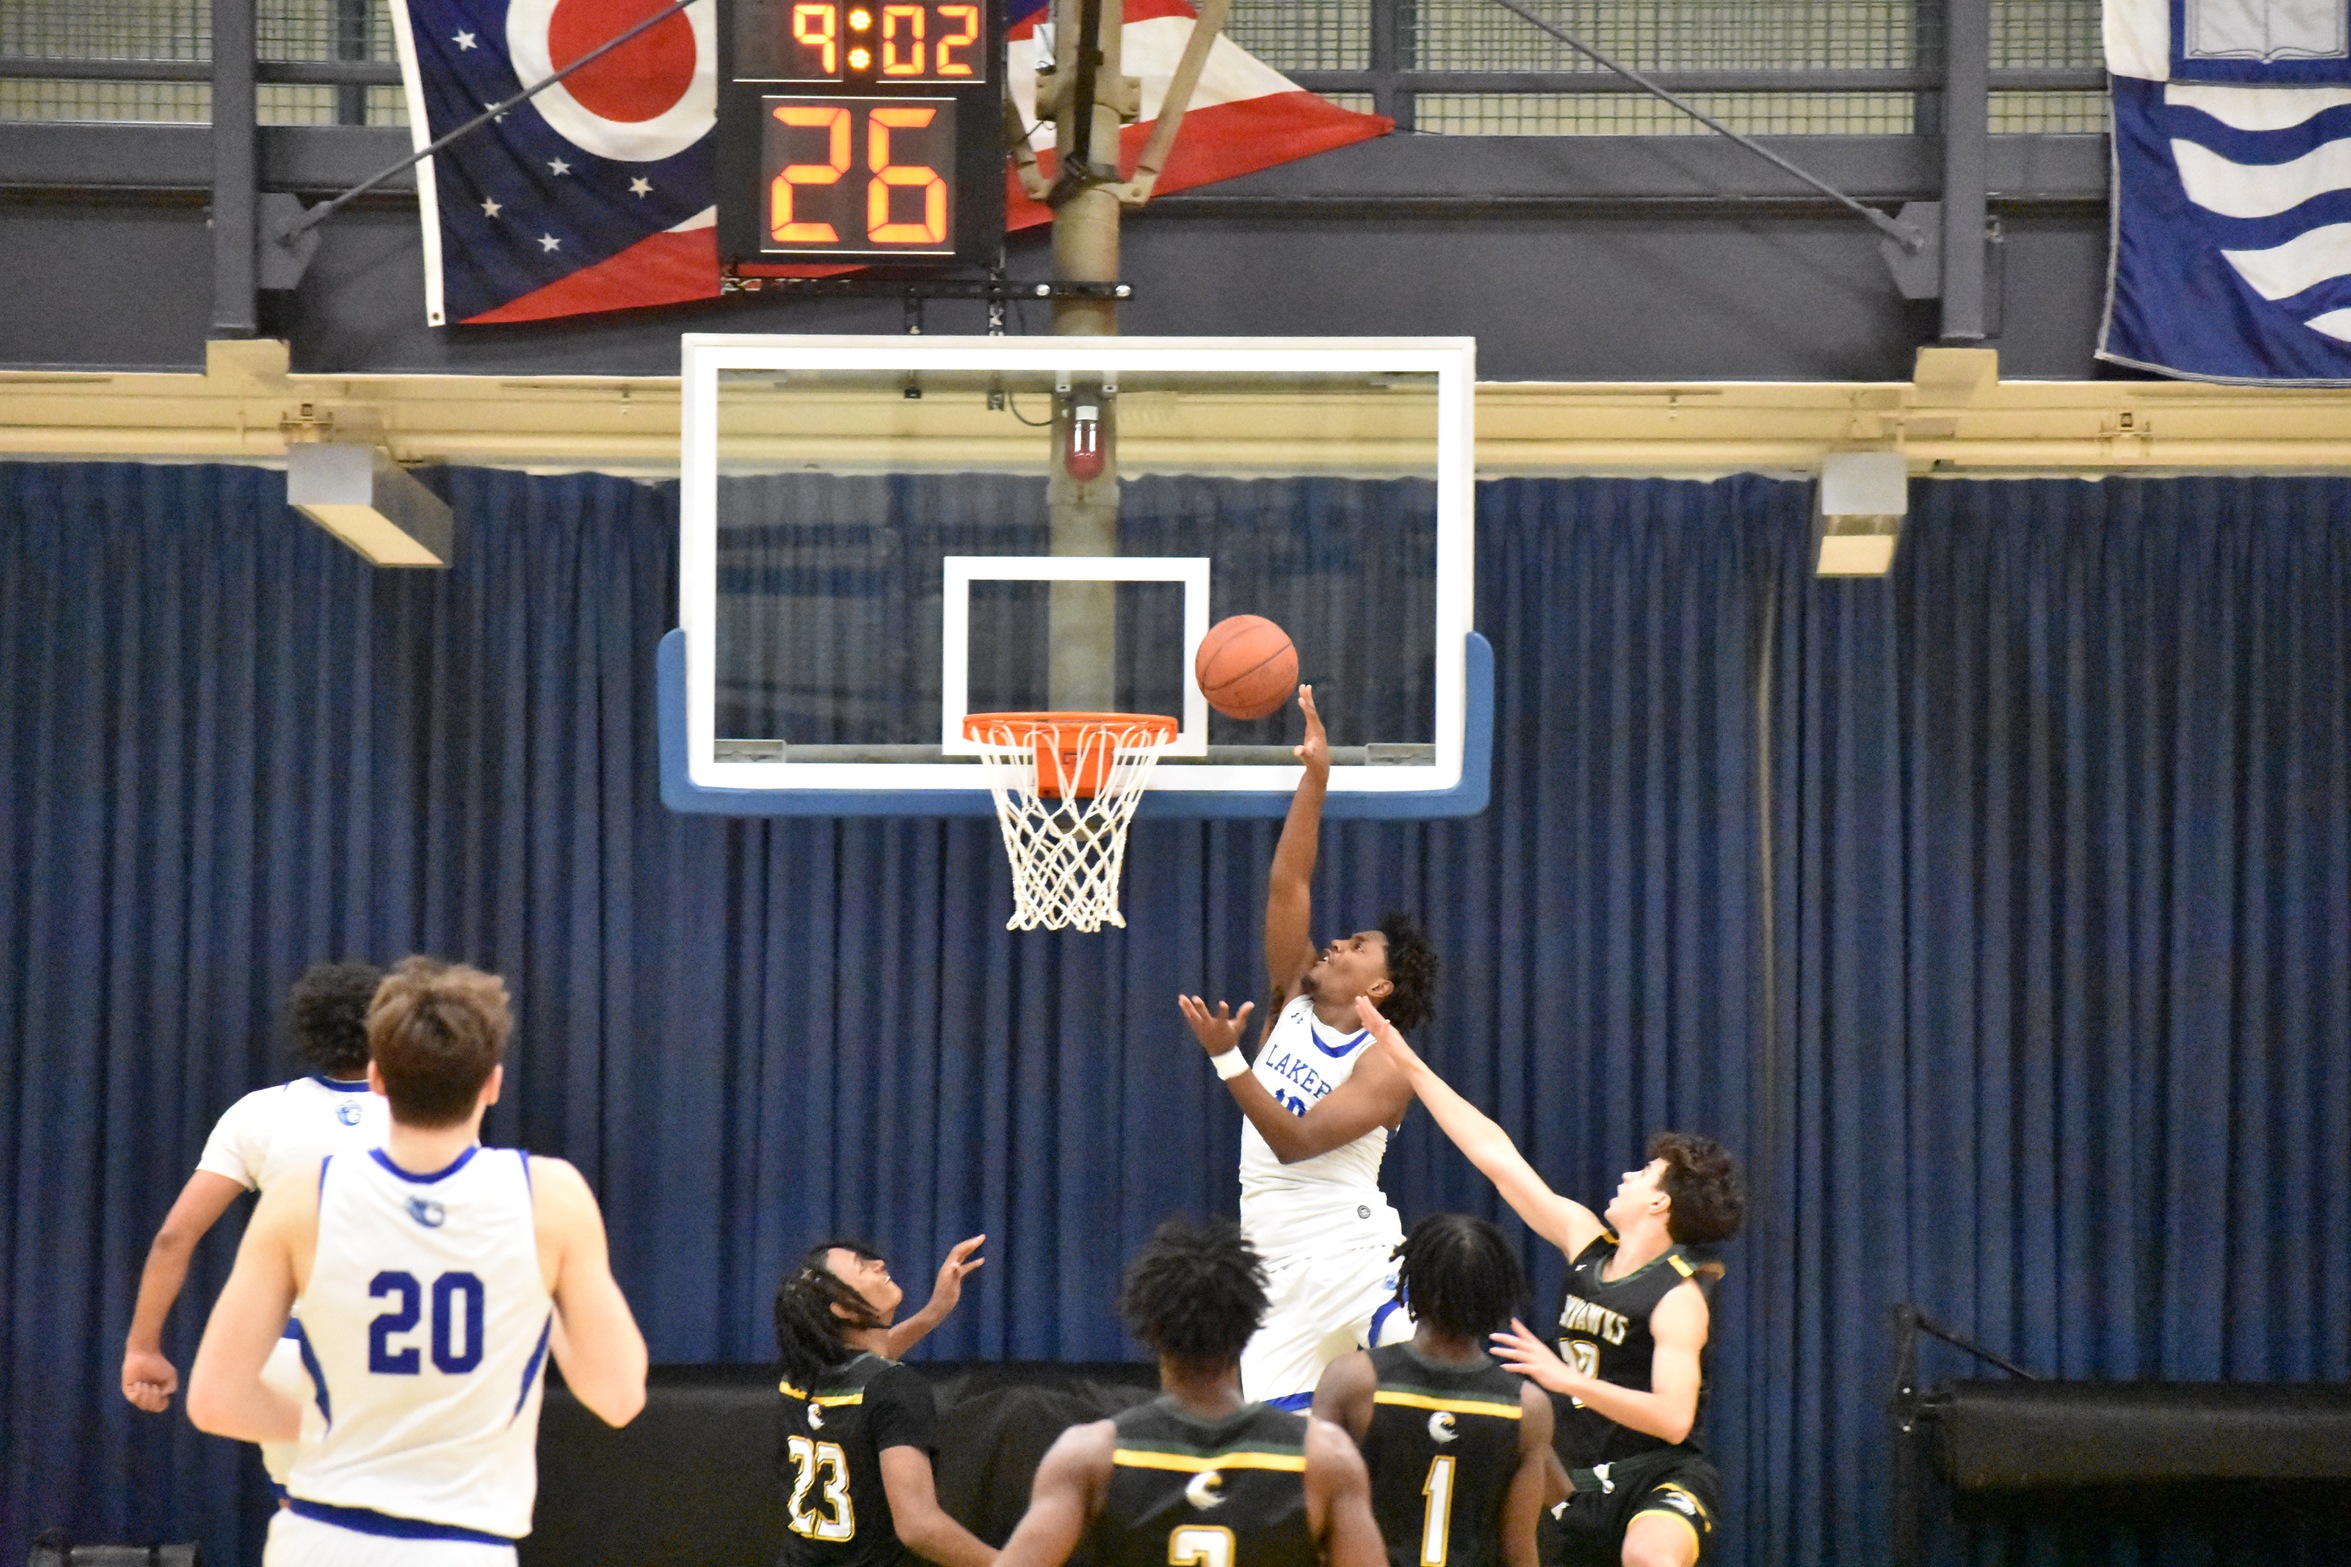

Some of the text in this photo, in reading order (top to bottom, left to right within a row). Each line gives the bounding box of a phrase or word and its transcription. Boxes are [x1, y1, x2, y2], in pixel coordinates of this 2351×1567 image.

[792, 3, 979, 75] 9:02
[771, 106, 947, 243] 26
[368, 1270, 485, 1376] 20
[787, 1434, 856, 1543] 23
[1420, 1454, 1457, 1567] 1
